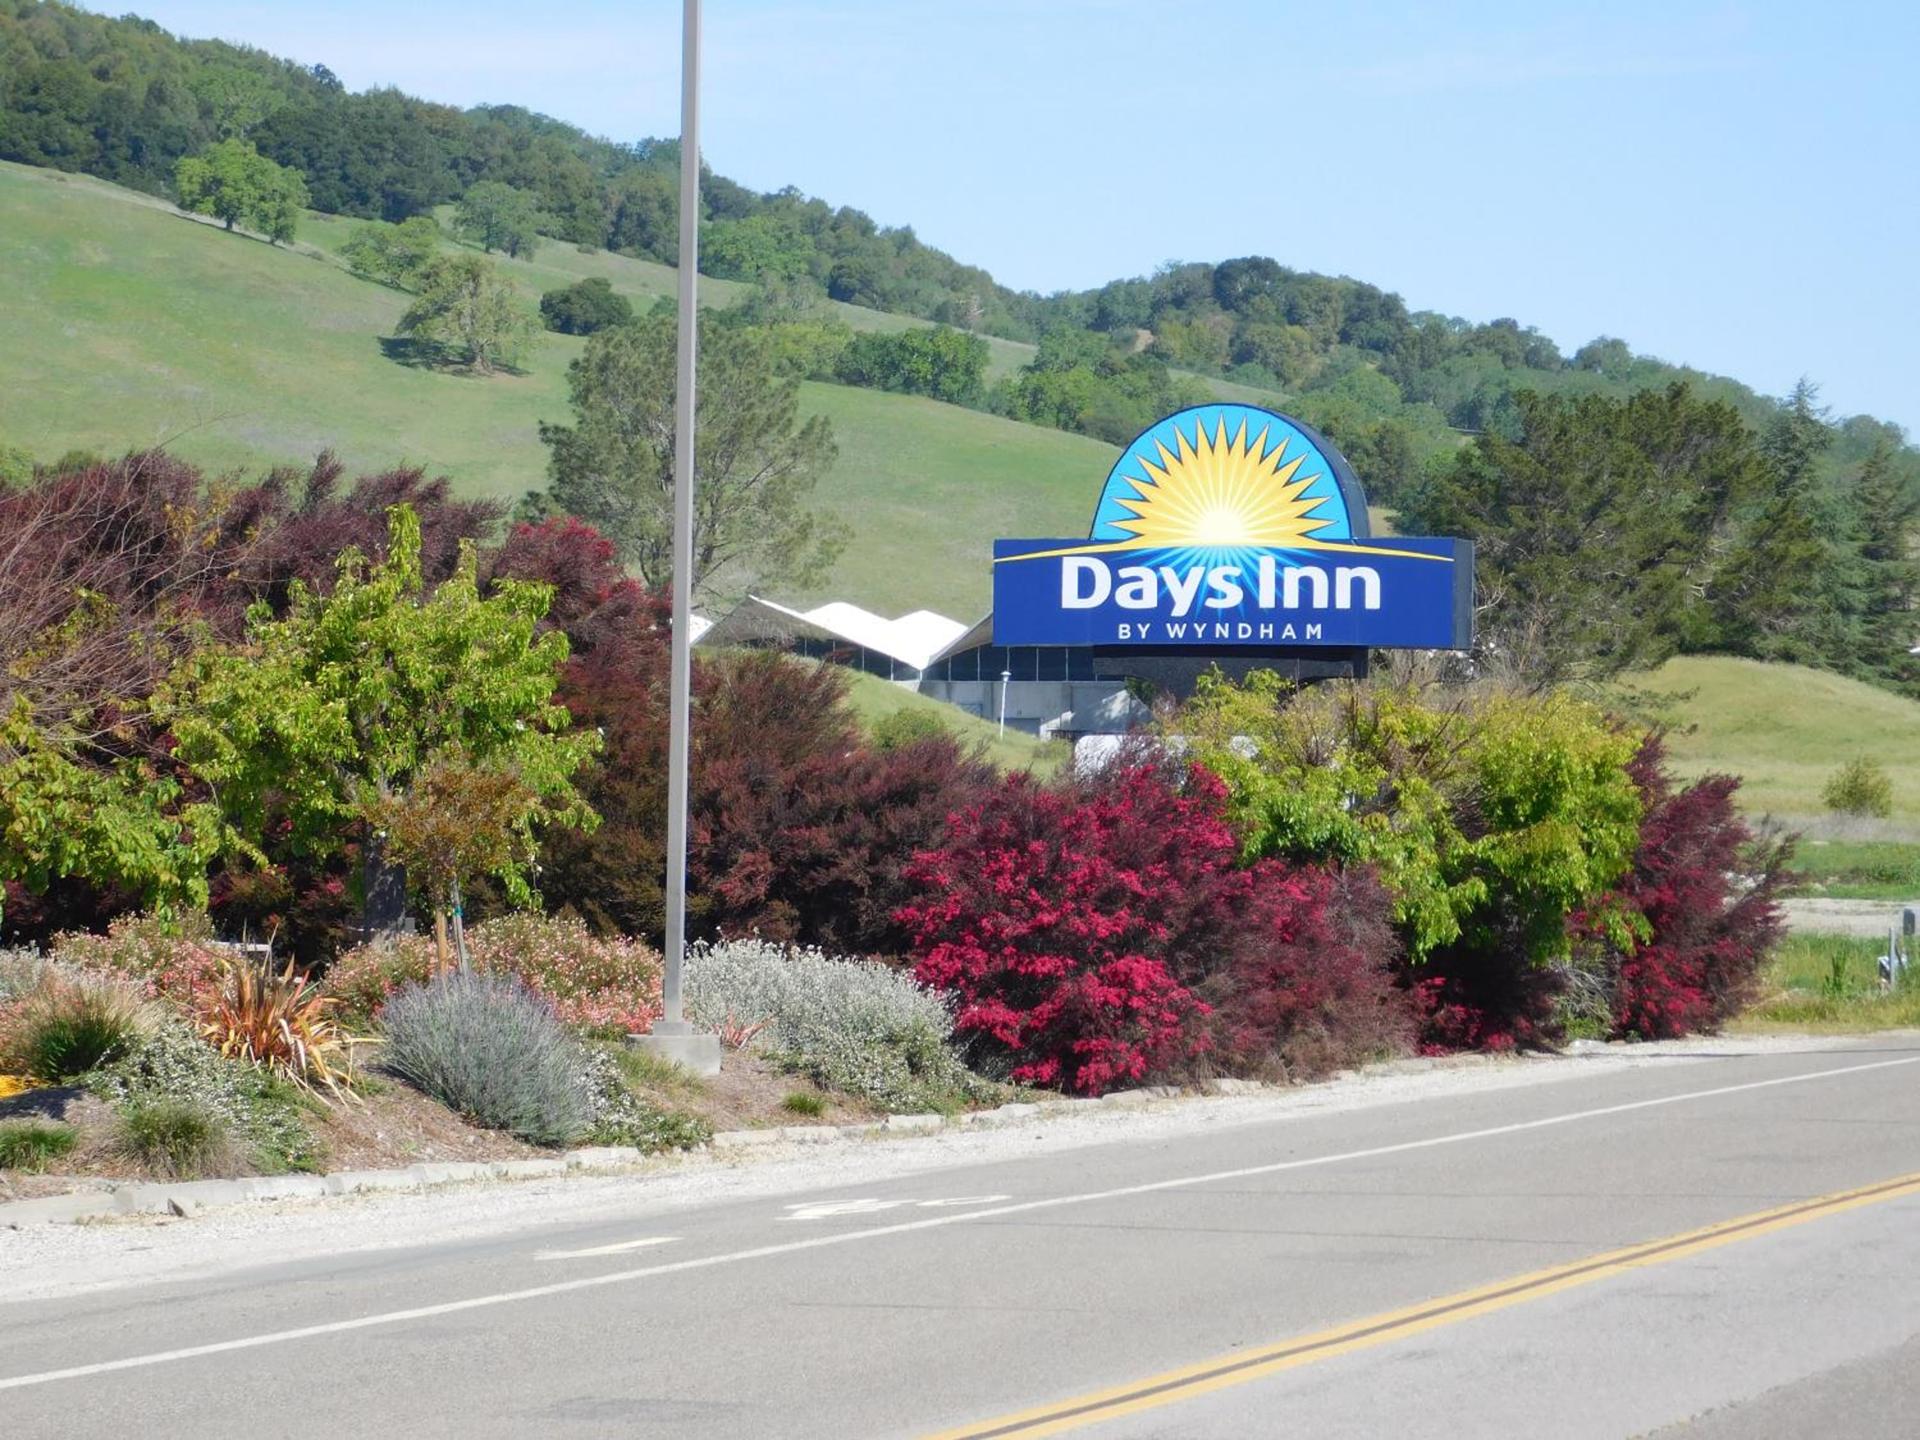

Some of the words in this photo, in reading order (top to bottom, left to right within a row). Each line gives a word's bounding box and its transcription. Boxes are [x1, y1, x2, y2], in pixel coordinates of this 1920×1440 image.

[1061, 556, 1244, 617] Days
[1258, 555, 1381, 610] Inn
[1118, 622, 1150, 640] BY
[1166, 622, 1322, 640] WYNDHAM
